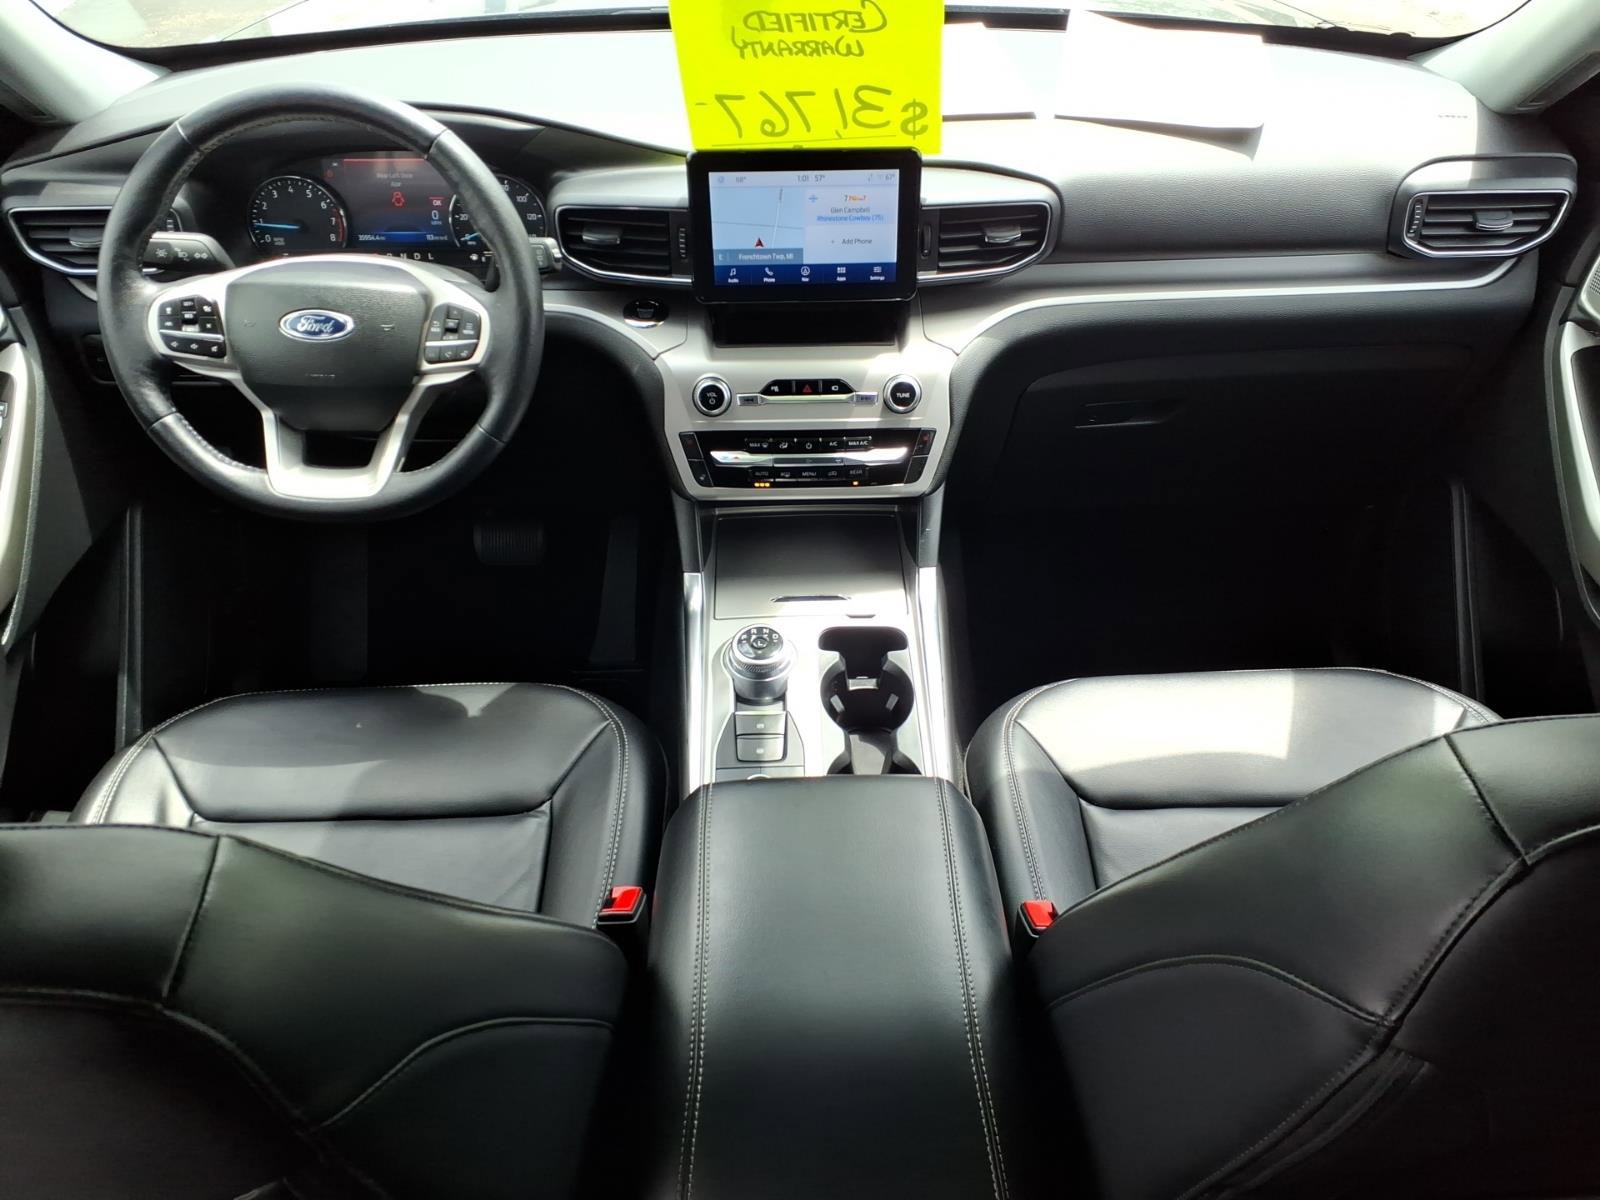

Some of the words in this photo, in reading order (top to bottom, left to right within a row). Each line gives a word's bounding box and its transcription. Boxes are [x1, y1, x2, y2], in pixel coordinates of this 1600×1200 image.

[272, 190, 278, 198] 3
[306, 190, 312, 198] 5
[261, 202, 268, 210] 2
[320, 201, 327, 209] 6
[431, 210, 439, 220] 0
[844, 207, 870, 215] Campbell
[264, 235, 271, 243] 0
[329, 234, 336, 242] 8
[738, 253, 770, 261] Frenchtown
[296, 315, 335, 332] Ford
